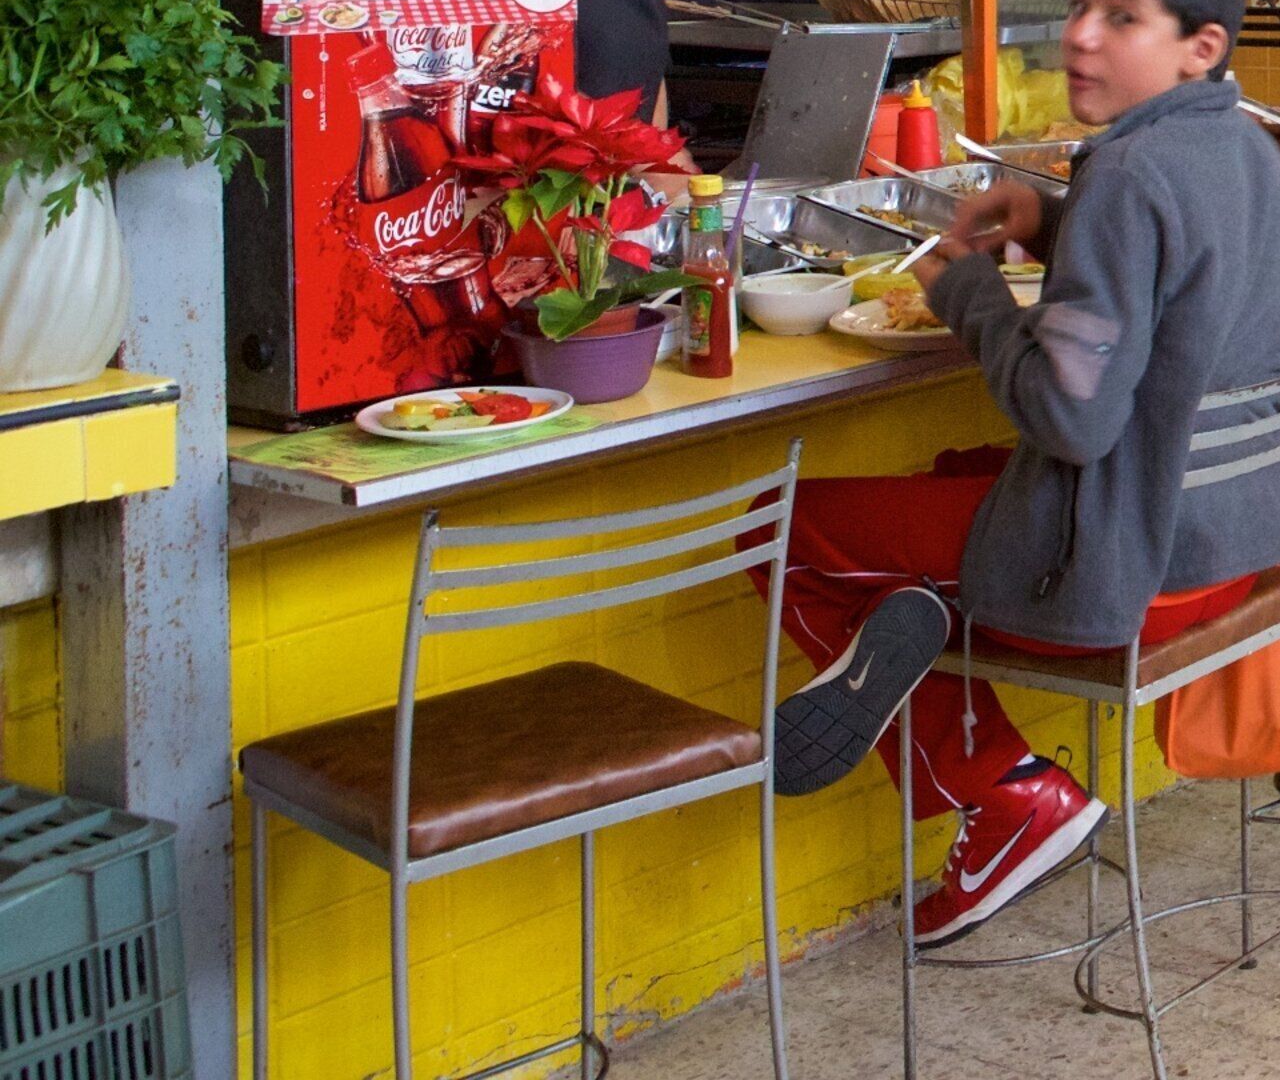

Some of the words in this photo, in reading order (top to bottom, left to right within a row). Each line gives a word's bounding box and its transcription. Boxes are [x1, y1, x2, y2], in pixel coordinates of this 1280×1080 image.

[416, 53, 453, 71] light
[476, 84, 516, 107] zer
[374, 178, 466, 254] Coca-Col
